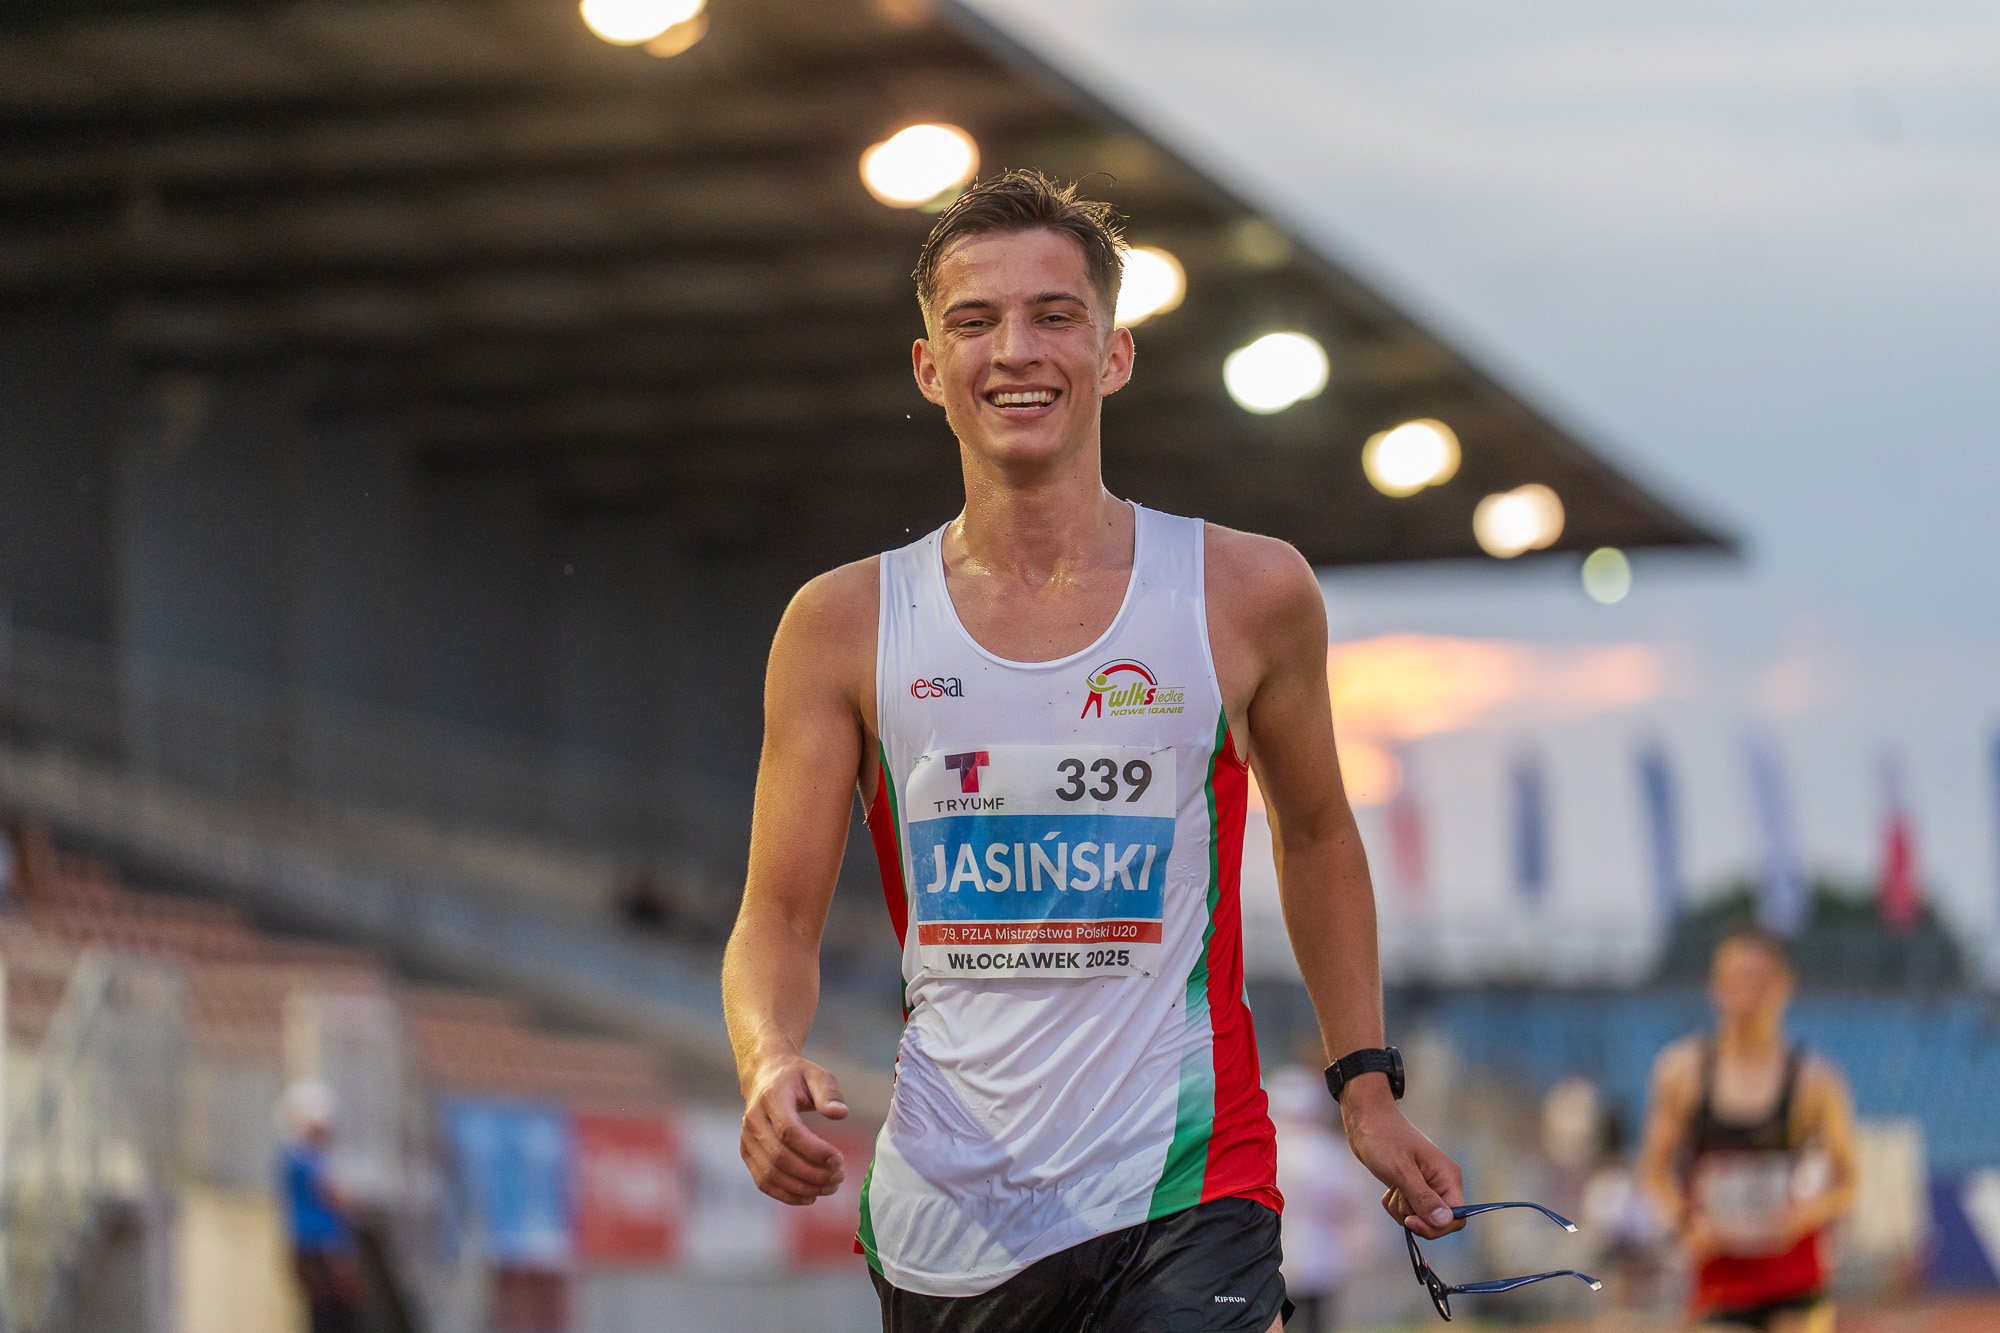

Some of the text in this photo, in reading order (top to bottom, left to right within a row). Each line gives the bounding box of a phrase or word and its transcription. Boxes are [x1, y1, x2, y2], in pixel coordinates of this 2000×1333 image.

[911, 677, 965, 699] esa
[1110, 706, 1184, 717] NOWE IGANIE
[1055, 758, 1152, 802] 339
[933, 797, 1005, 813] TRYUMF
[926, 831, 1157, 893] JASIŃSKI
[941, 925, 1138, 940] 79. PZLA Mistrzostwa Polski U20
[947, 949, 1130, 970] WŁOCŁAWEK 2025
[1214, 1295, 1246, 1303] KIPRUN
